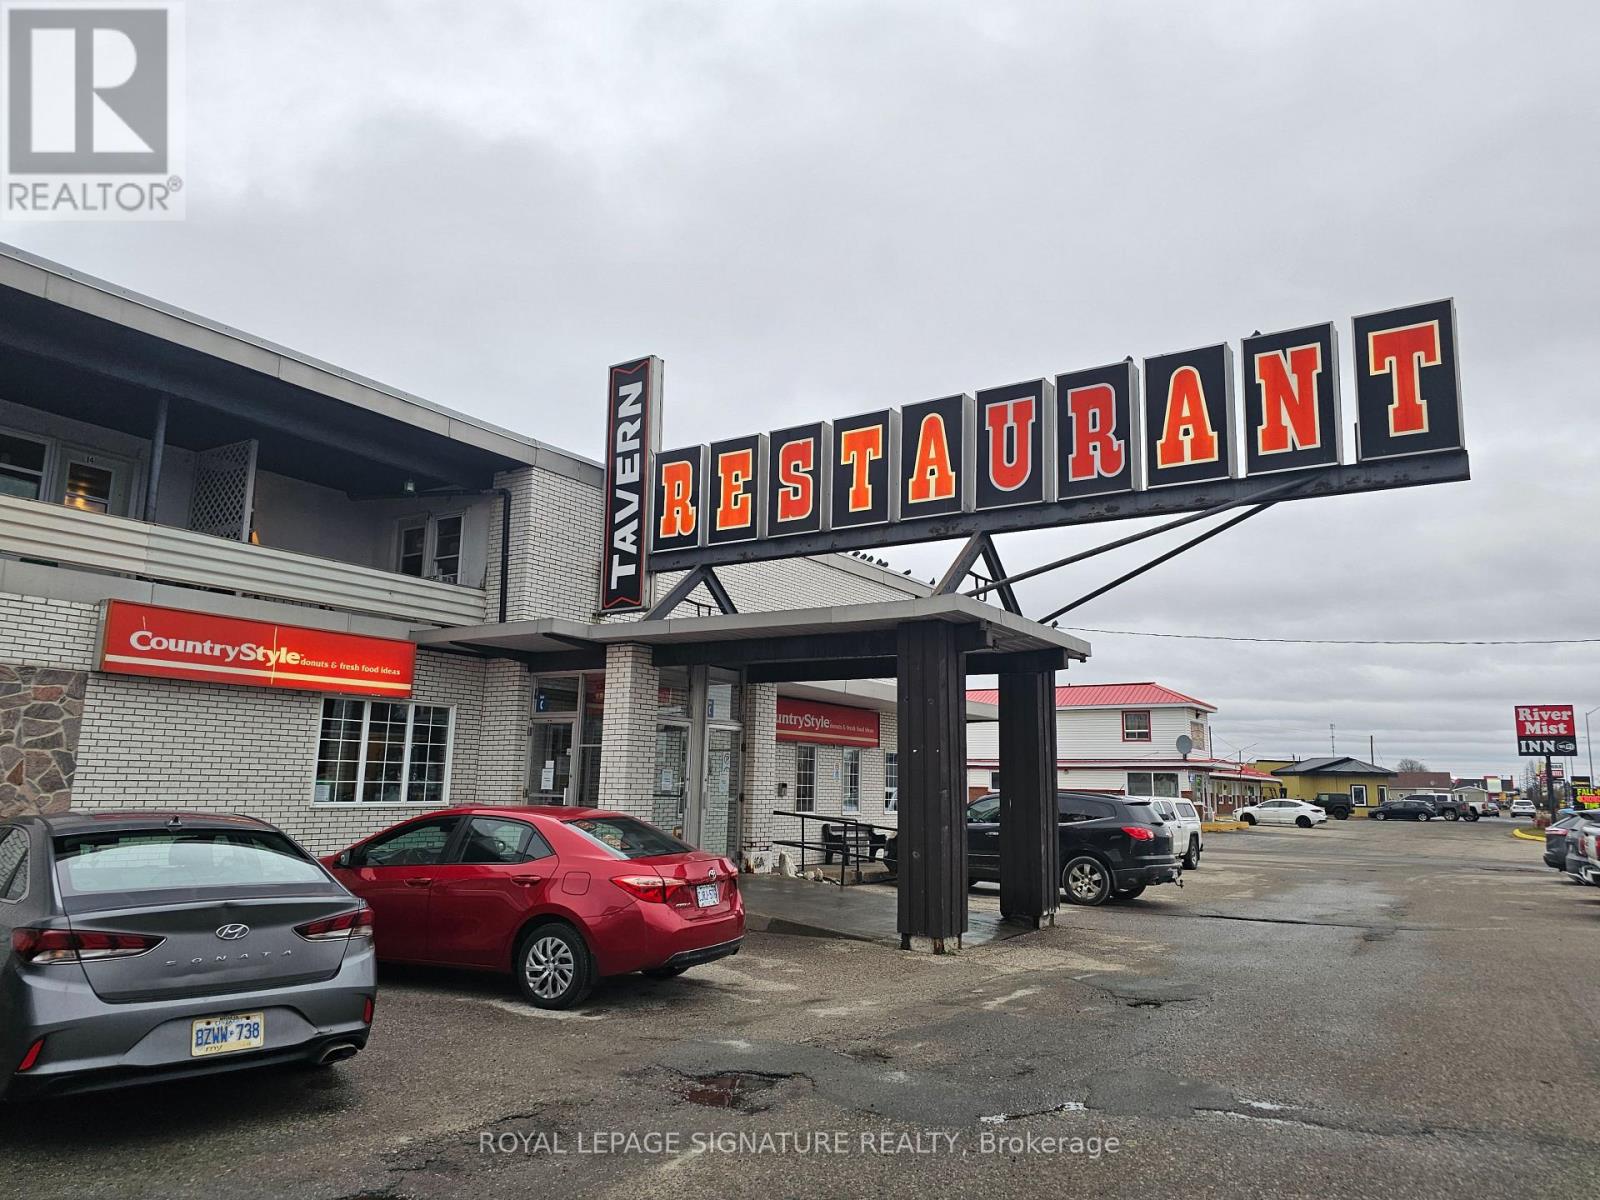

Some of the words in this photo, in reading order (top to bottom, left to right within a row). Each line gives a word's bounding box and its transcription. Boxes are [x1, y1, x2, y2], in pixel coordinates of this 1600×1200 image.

[658, 318, 1443, 539] RESTAURANT
[610, 380, 643, 590] TAVERN
[130, 630, 300, 666] CountryStyle
[300, 659, 328, 669] donuts
[331, 661, 338, 669] &
[339, 662, 360, 671] fresh
[361, 664, 379, 674] food
[381, 666, 401, 676] ideas
[775, 712, 830, 731] untryStyle
[1518, 708, 1572, 721] River
[1525, 722, 1568, 735] Mist
[1520, 741, 1555, 753] INN
